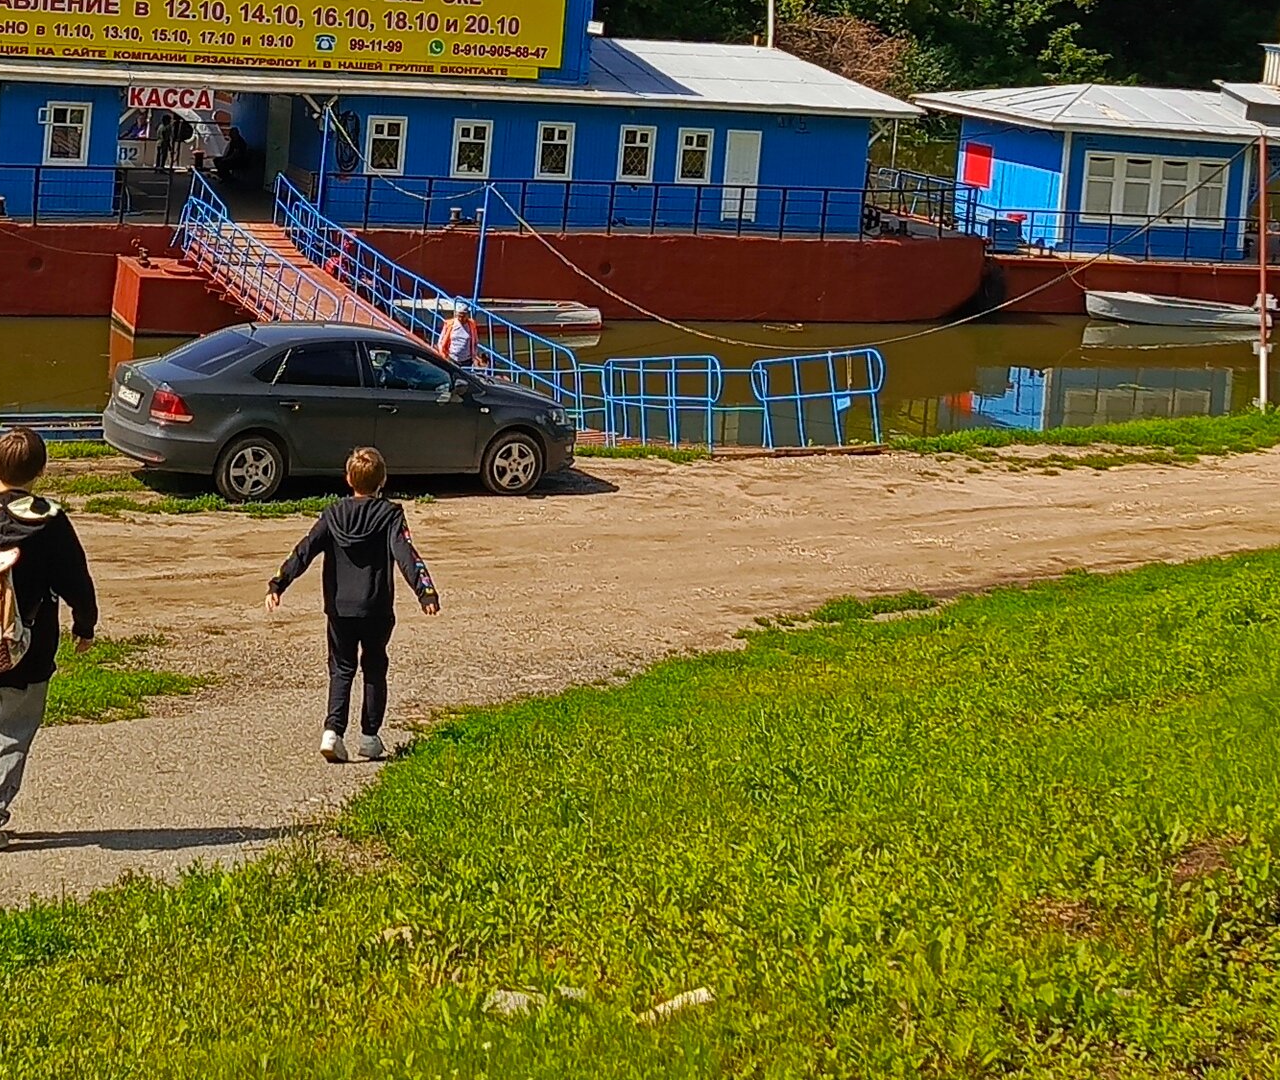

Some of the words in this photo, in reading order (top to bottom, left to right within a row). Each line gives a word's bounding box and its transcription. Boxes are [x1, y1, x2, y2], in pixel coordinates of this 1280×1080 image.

[134, 0, 150, 16] в
[239, 2, 304, 28] 14.10,
[312, 7, 375, 32] 16.10,
[383, 10, 440, 32] 18.10
[445, 18, 458, 33] и
[464, 14, 520, 36] 20.10
[36, 25, 46, 36] в
[54, 23, 94, 40] 11.10,
[102, 25, 143, 42] 13.10,
[151, 28, 191, 45] 15.10,
[199, 31, 235, 45] 17.10
[242, 35, 251, 46] и
[259, 33, 294, 48] 19.10
[349, 38, 403, 53] 99-11-99
[452, 42, 548, 59] 8-910-905-68-47
[36, 46, 55, 56] НА
[62, 48, 107, 58] САЙТЕ
[113, 50, 187, 63] КОМПАНИИ
[193, 54, 302, 67] РЯЗАНЬТУРФЛОТ
[307, 59, 317, 68] И
[323, 60, 331, 69] В
[338, 60, 383, 71] НАШЕЙ
[389, 64, 434, 73] ГРУППЕ
[440, 66, 508, 76] ВКОНТАКТЕ
[129, 87, 212, 109] КАССА
